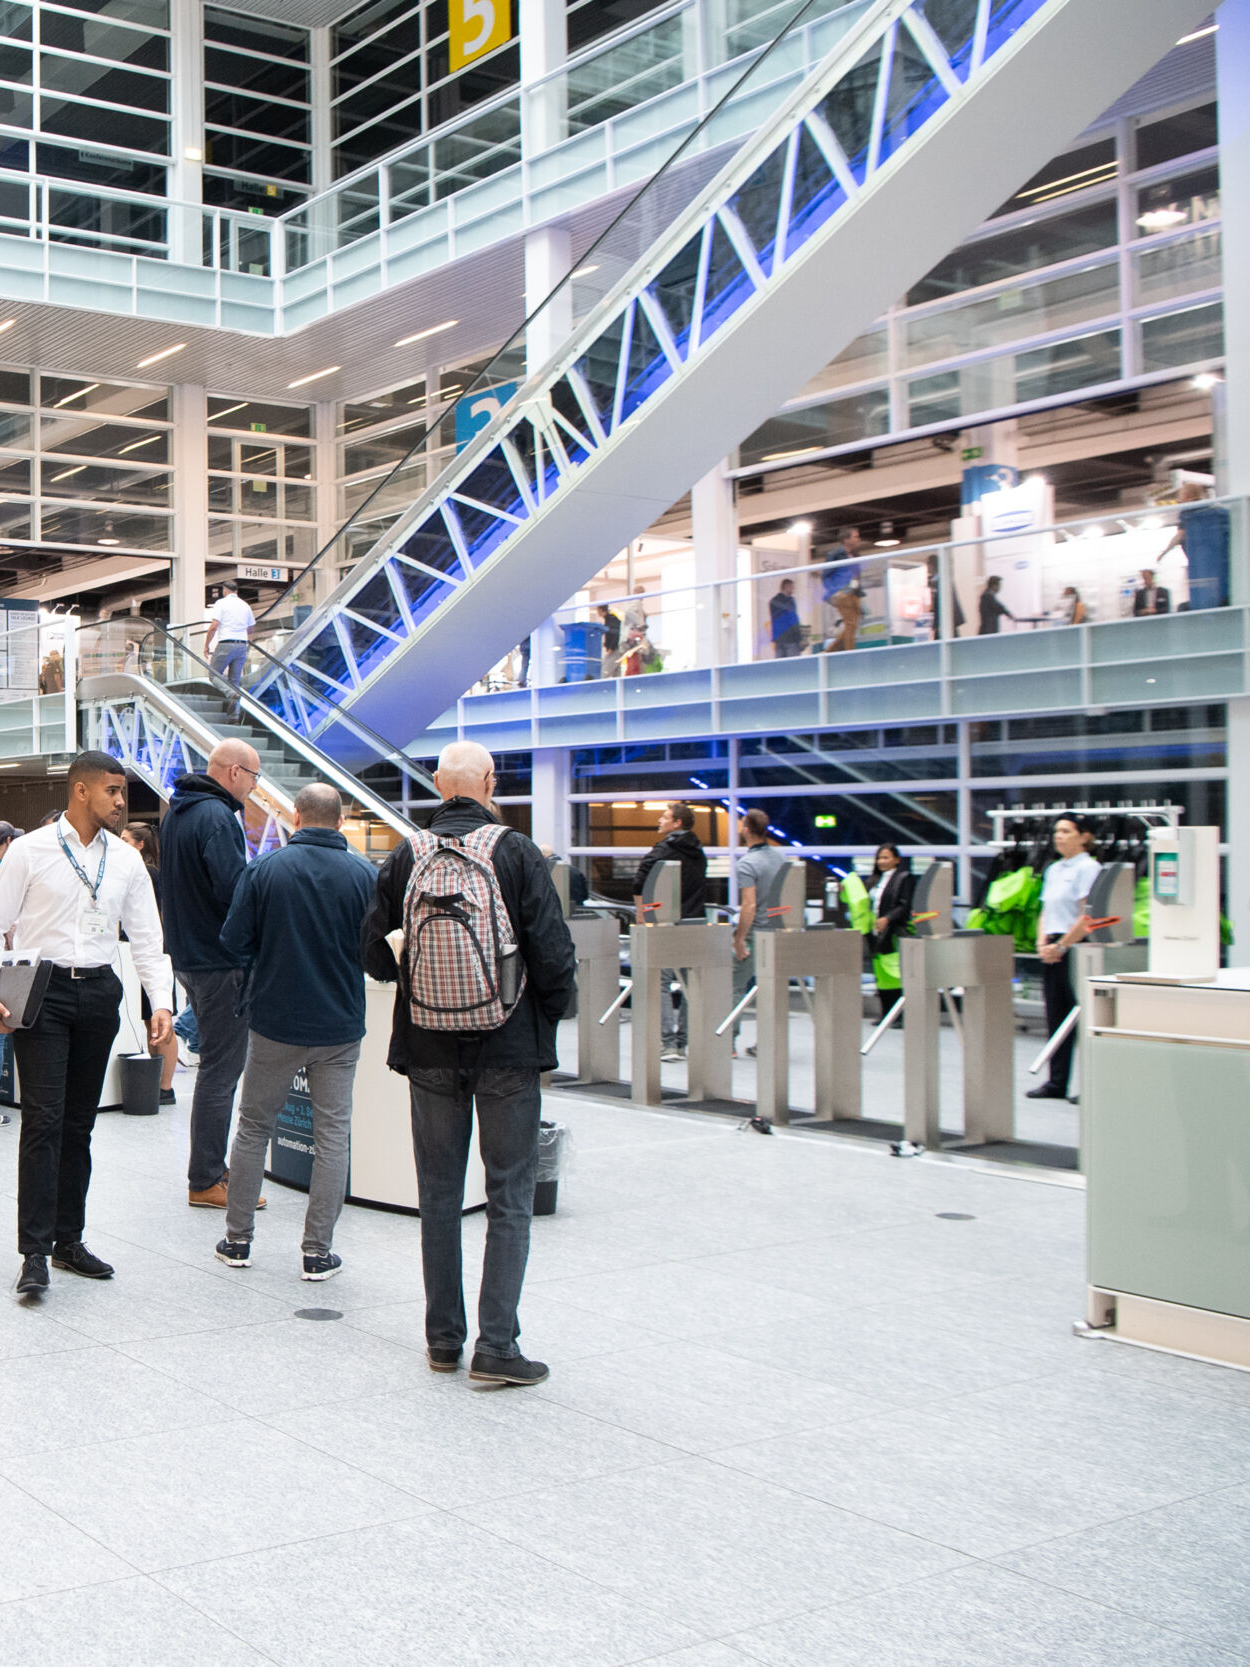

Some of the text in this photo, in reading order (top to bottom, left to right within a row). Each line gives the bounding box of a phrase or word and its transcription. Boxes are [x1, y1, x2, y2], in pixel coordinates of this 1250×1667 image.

[463, 0, 495, 56] 5
[246, 567, 279, 579] Halle 3
